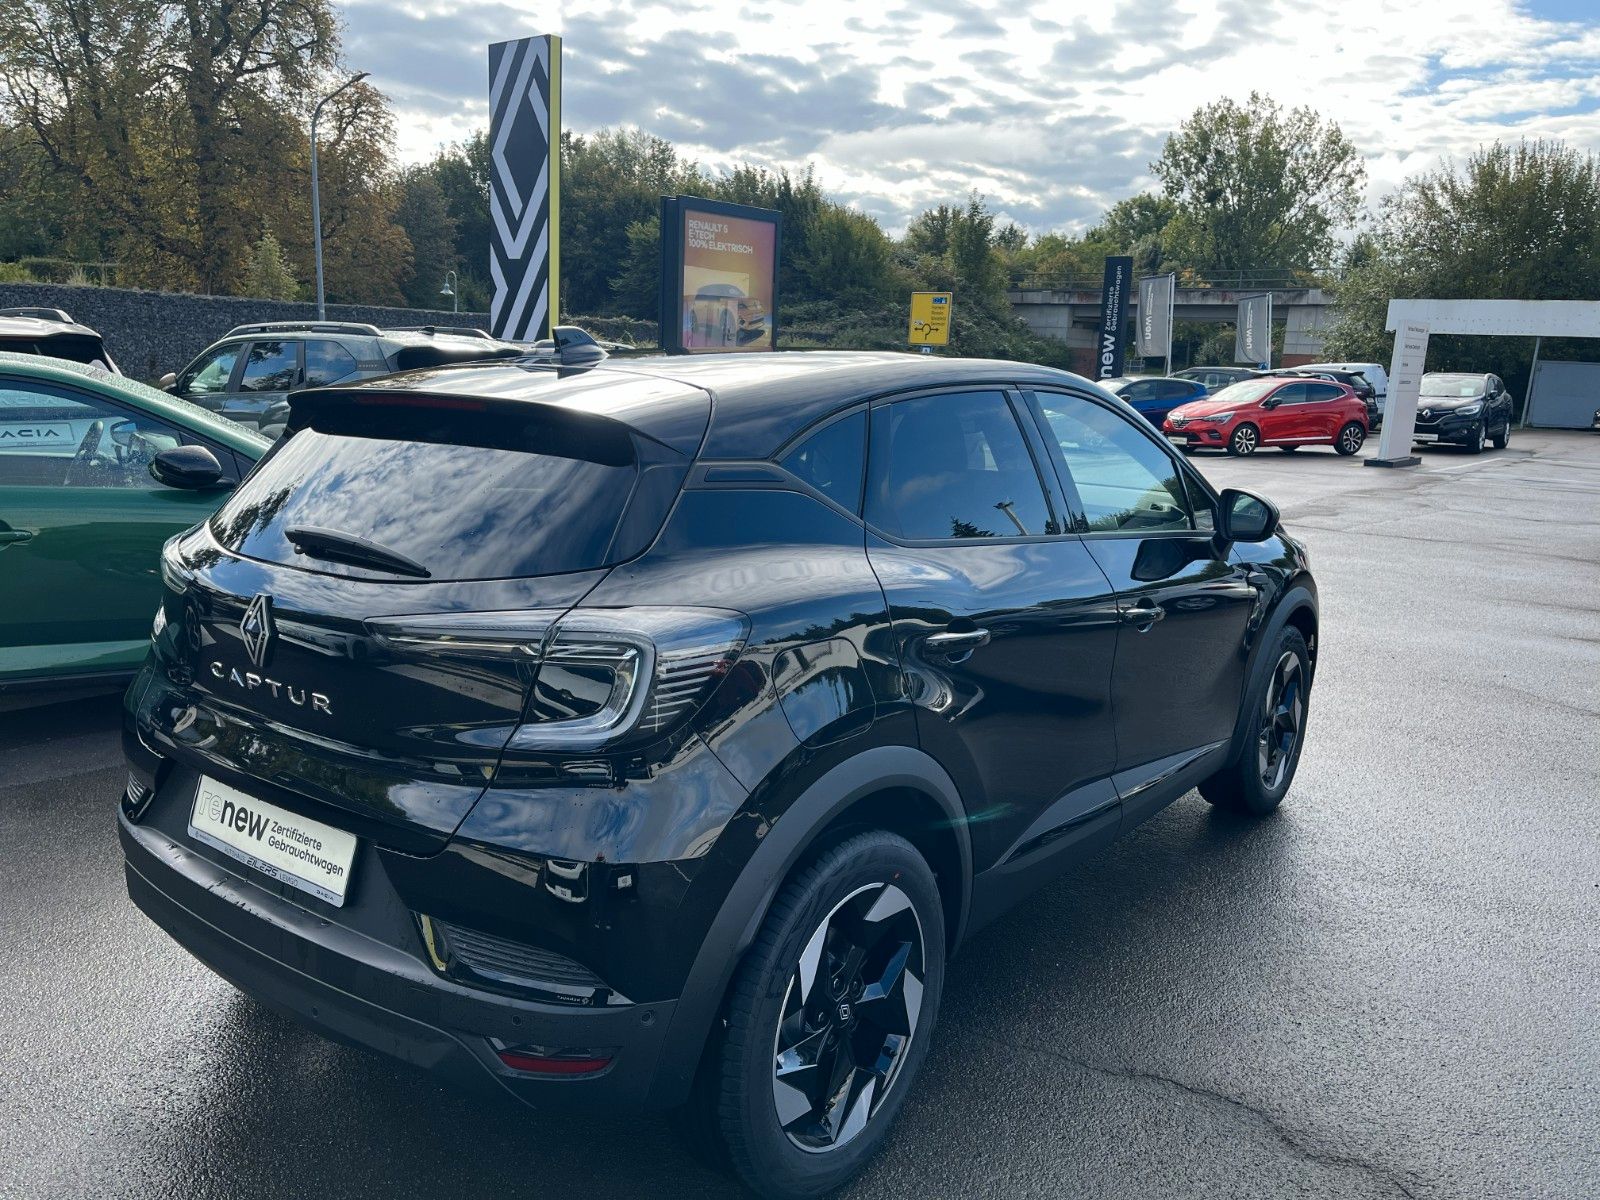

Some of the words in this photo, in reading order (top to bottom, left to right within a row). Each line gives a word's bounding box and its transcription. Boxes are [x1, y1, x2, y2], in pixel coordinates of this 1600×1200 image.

[688, 220, 722, 232] RENAULT
[688, 238, 708, 248] 100%
[709, 241, 753, 253] ELEKTRISCH
[1105, 286, 1114, 330] Zertifizierte
[1111, 265, 1122, 331] Gebrauchtwagen
[209, 661, 333, 716] CAPTUR
[198, 790, 271, 842] renew
[270, 820, 323, 852] Zertifizierte
[246, 856, 279, 877] EILERS
[267, 835, 344, 877] Gebrauchtwagen
